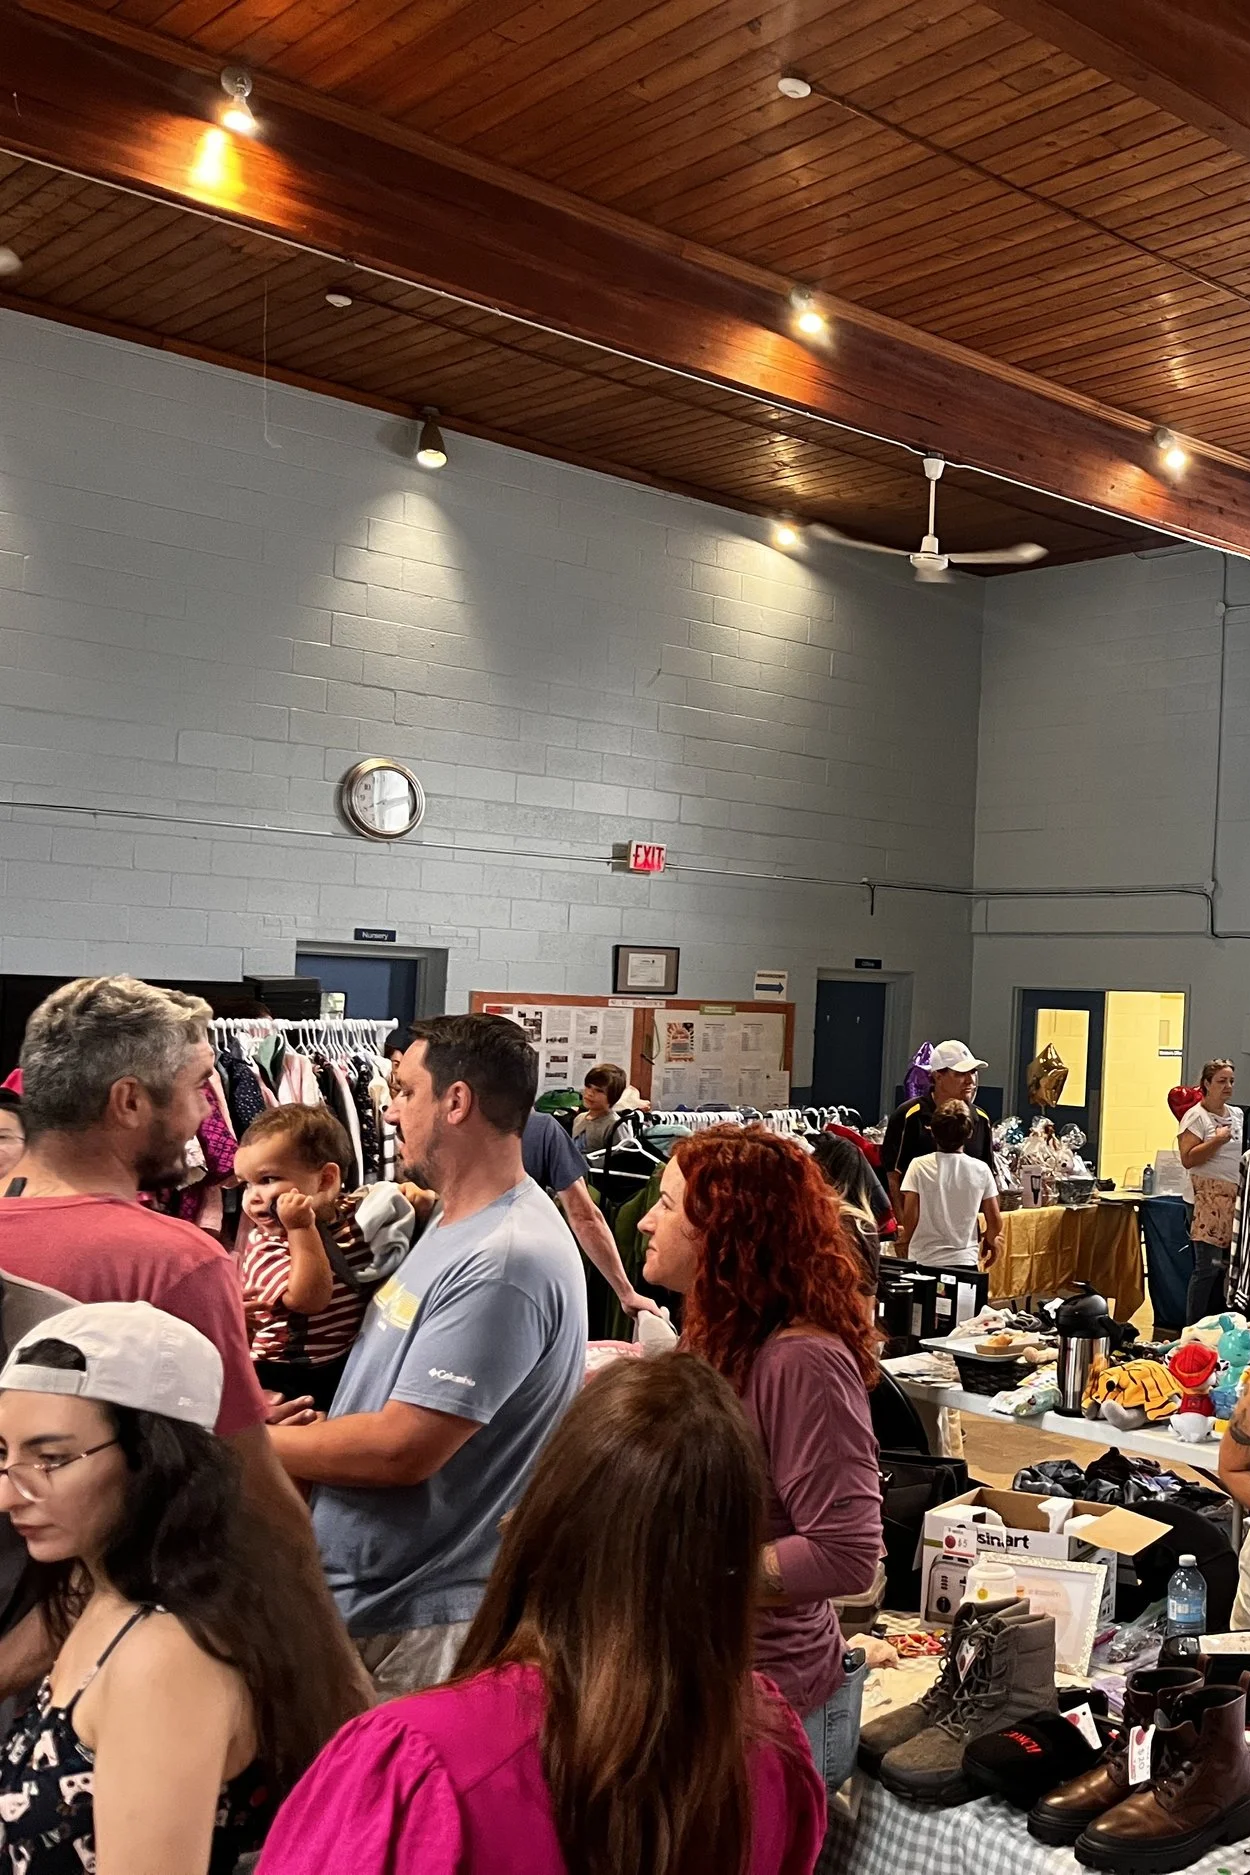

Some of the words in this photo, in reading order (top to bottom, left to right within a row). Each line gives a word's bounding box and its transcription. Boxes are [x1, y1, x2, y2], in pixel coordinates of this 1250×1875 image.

[633, 844, 664, 870] EXIT
[361, 931, 389, 941] Nursery
[437, 1369, 476, 1387] Columbia
